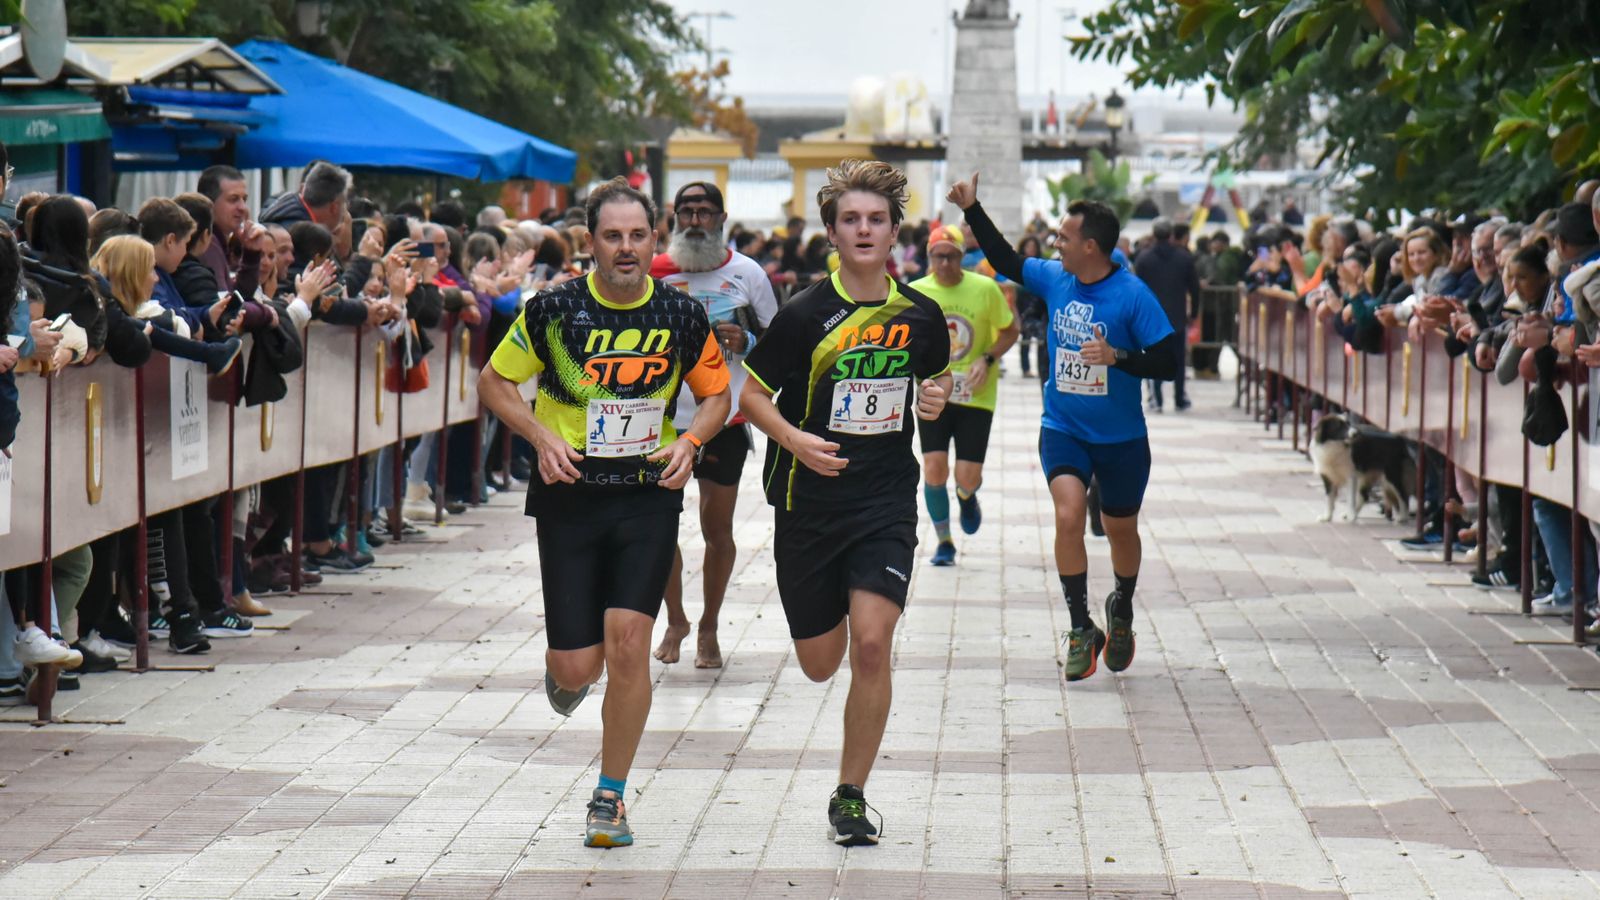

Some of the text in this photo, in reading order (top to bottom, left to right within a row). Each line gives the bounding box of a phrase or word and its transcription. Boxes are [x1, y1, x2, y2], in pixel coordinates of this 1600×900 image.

[823, 308, 848, 331] Joma
[578, 357, 669, 385] STOP
[830, 350, 910, 380] STOP
[847, 382, 873, 394] XIV
[600, 403, 625, 415] XIV
[865, 394, 878, 416] 8
[620, 415, 632, 437] 7
